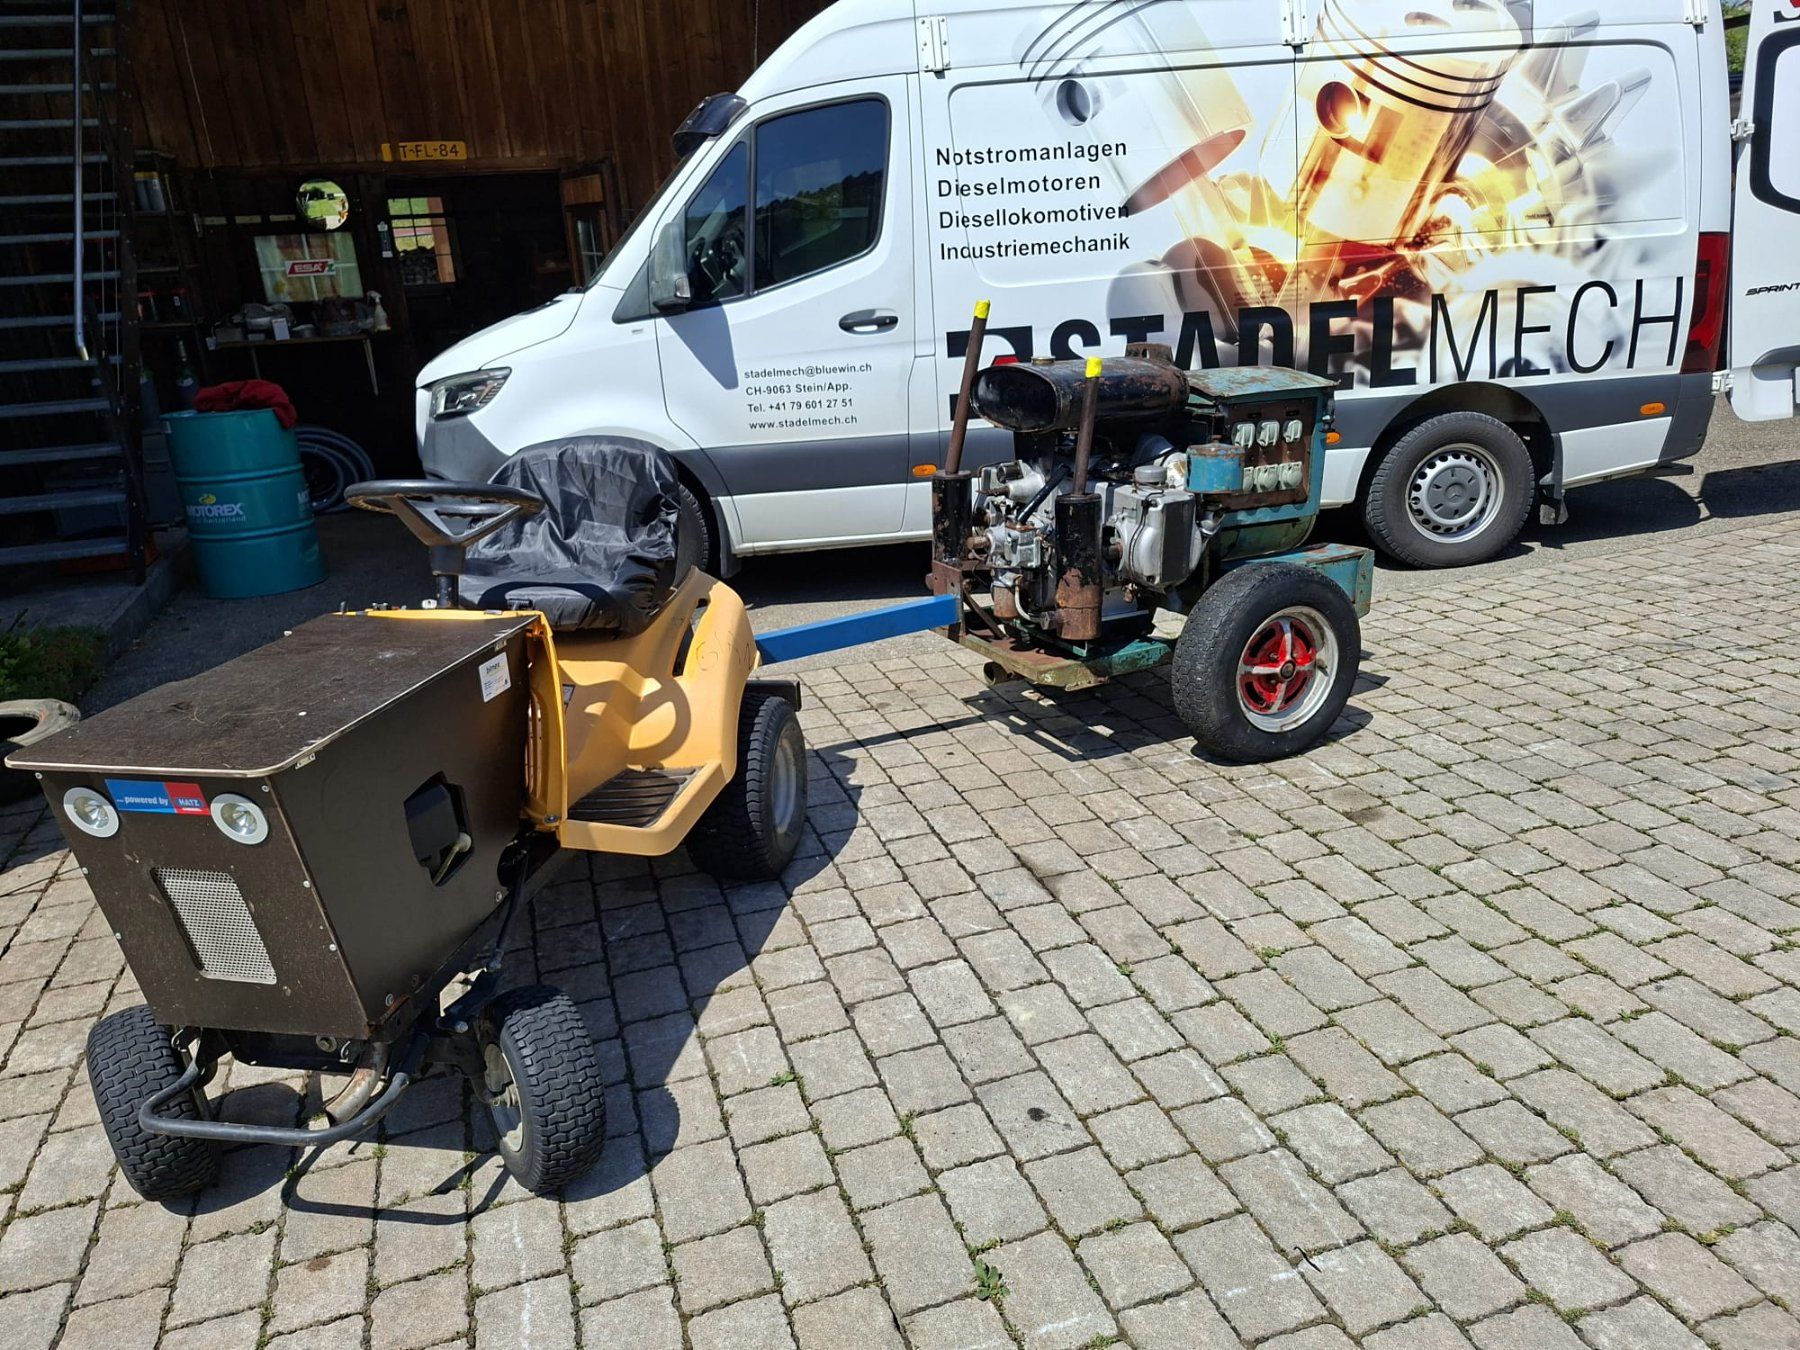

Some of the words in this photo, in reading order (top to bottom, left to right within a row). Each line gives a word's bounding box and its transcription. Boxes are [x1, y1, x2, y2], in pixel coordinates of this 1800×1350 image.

[936, 140, 1128, 166] Notstromanlagen
[937, 174, 1101, 198] Dieselmotoren
[939, 202, 1130, 229] Diesellokomotiven
[940, 232, 1131, 260] Industriemechanik
[744, 362, 872, 379] stadelmech@bluewin.ch
[745, 384, 792, 396] CH-9063
[795, 382, 853, 394] Stein/App.
[747, 403, 766, 413] Tel.
[768, 402, 786, 412] +41
[790, 401, 802, 410] 79
[805, 400, 823, 410] 601
[826, 399, 838, 408] 27
[841, 398, 853, 407] 51
[749, 414, 858, 430] www.stadelmech.ch
[186, 503, 244, 517] MOTOREX
